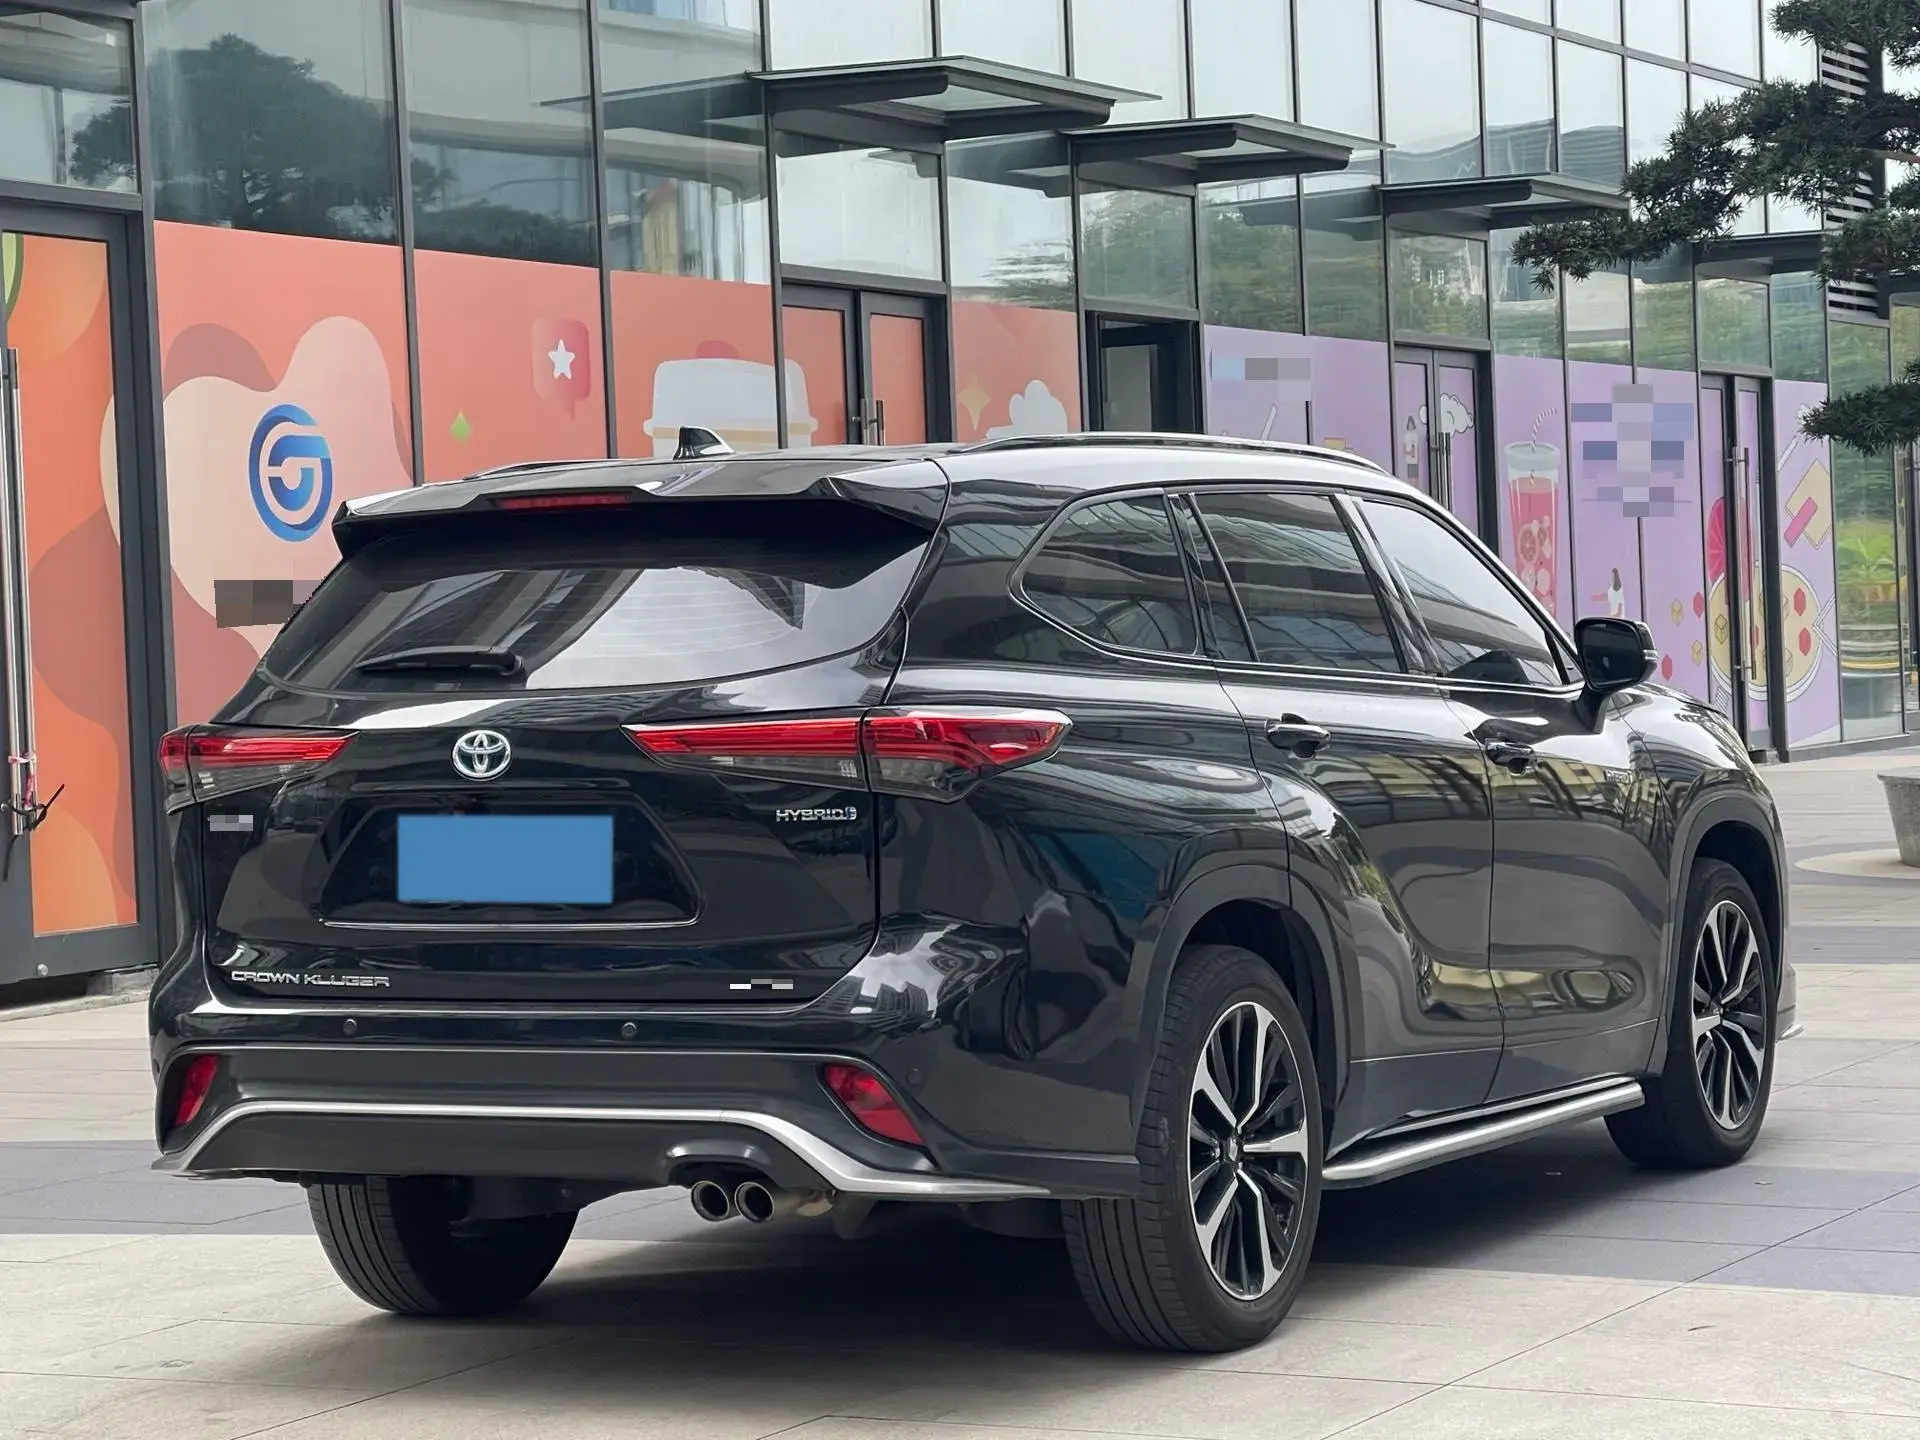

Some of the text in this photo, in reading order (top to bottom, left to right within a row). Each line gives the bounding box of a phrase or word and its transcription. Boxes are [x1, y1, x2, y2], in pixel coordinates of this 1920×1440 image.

[776, 808, 846, 821] HYBRID
[231, 970, 390, 987] CROWN KLUGER
